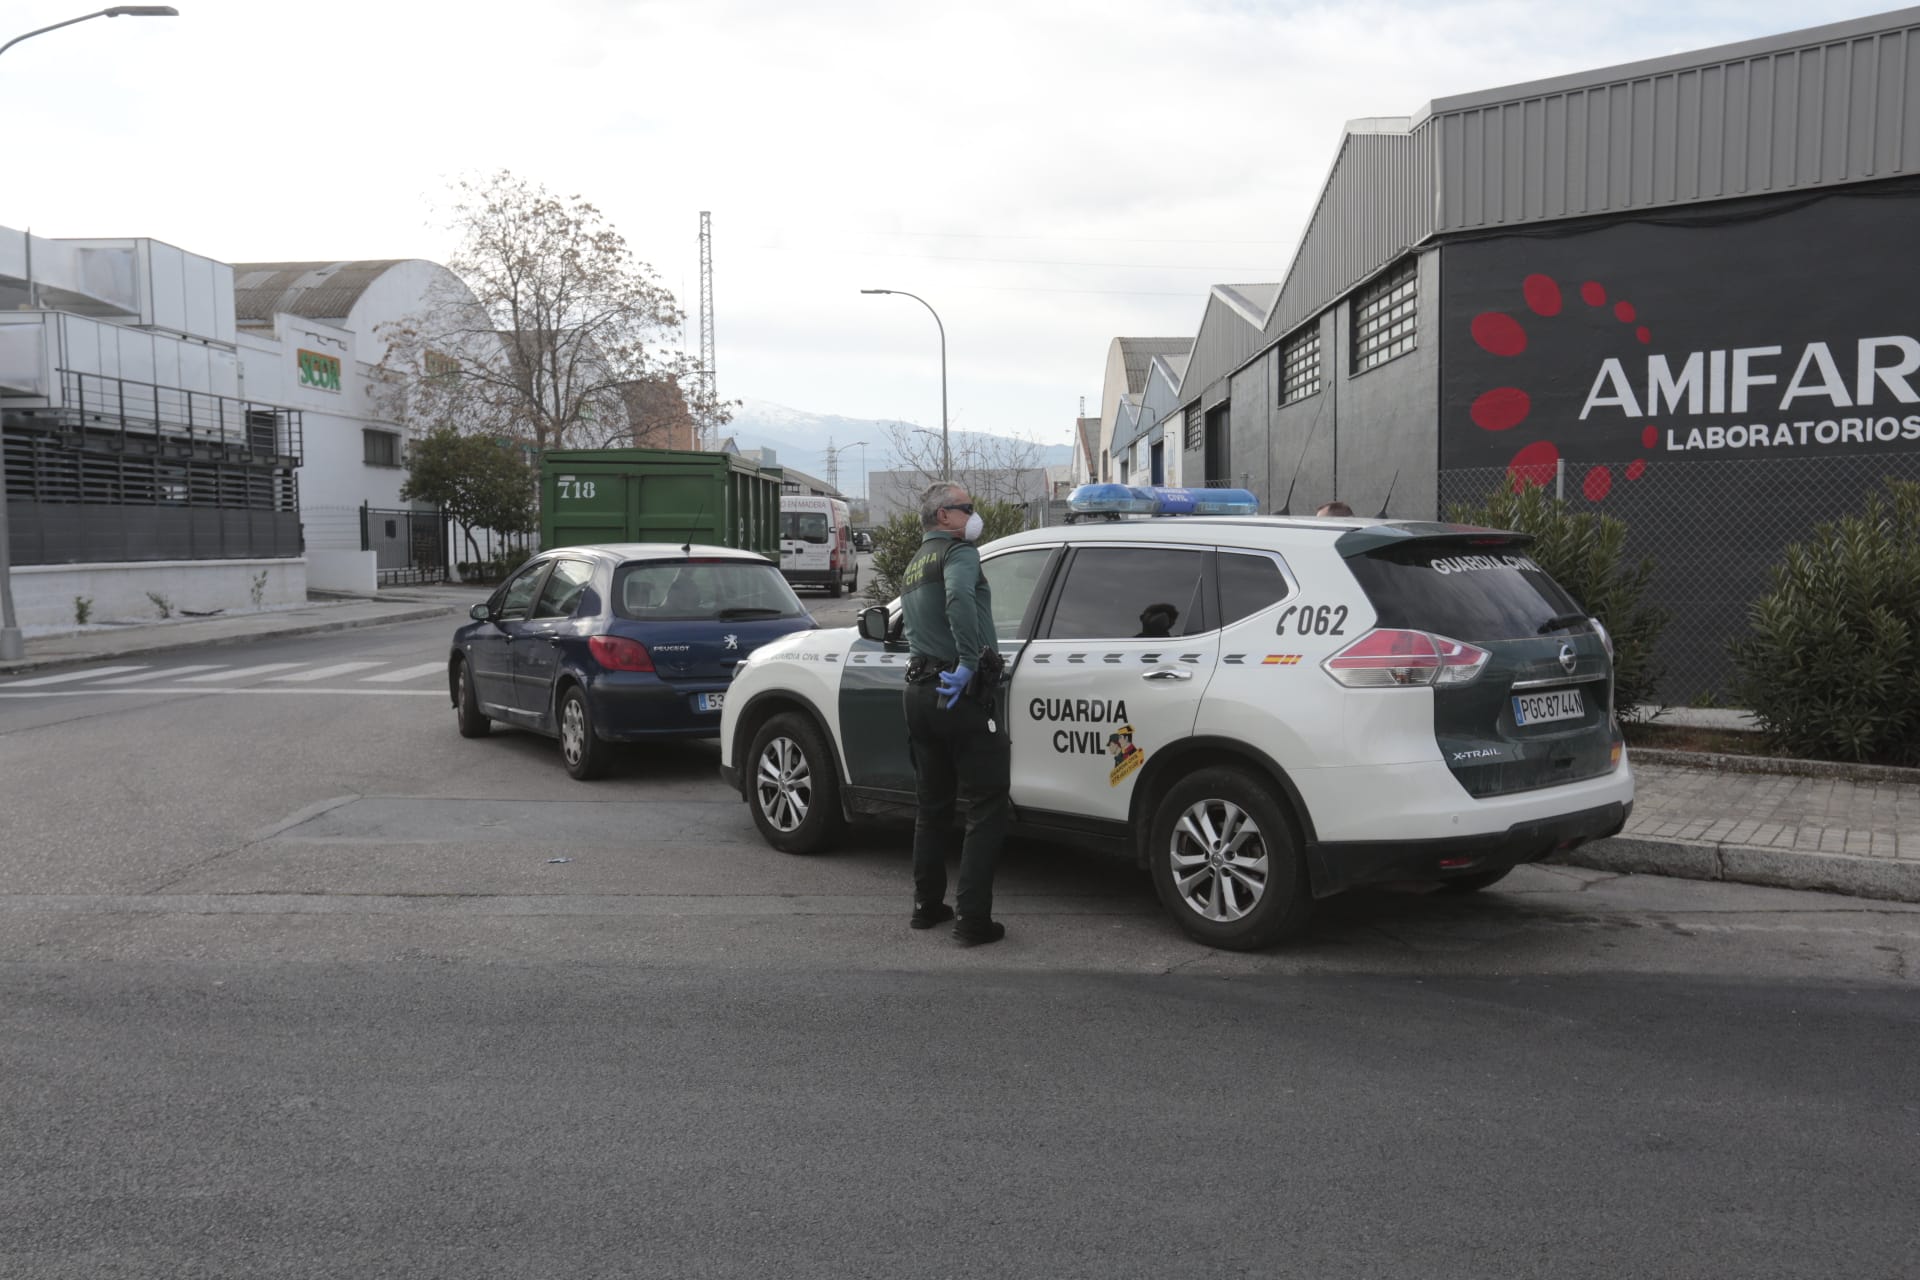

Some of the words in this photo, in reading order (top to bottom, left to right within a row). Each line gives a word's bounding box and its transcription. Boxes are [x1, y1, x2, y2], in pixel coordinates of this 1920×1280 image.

[1578, 335, 1920, 420] AMIFAR
[1667, 415, 1920, 450] LABORATORIOS
[558, 481, 596, 499] 718
[1430, 555, 1507, 575] GUARDIA
[1502, 555, 1541, 573] CIVIL
[1298, 605, 1348, 635] 062
[1029, 697, 1128, 723] GUARDIA
[1053, 729, 1106, 755] CIVIL
[1452, 749, 1502, 761] X-TRAIL
